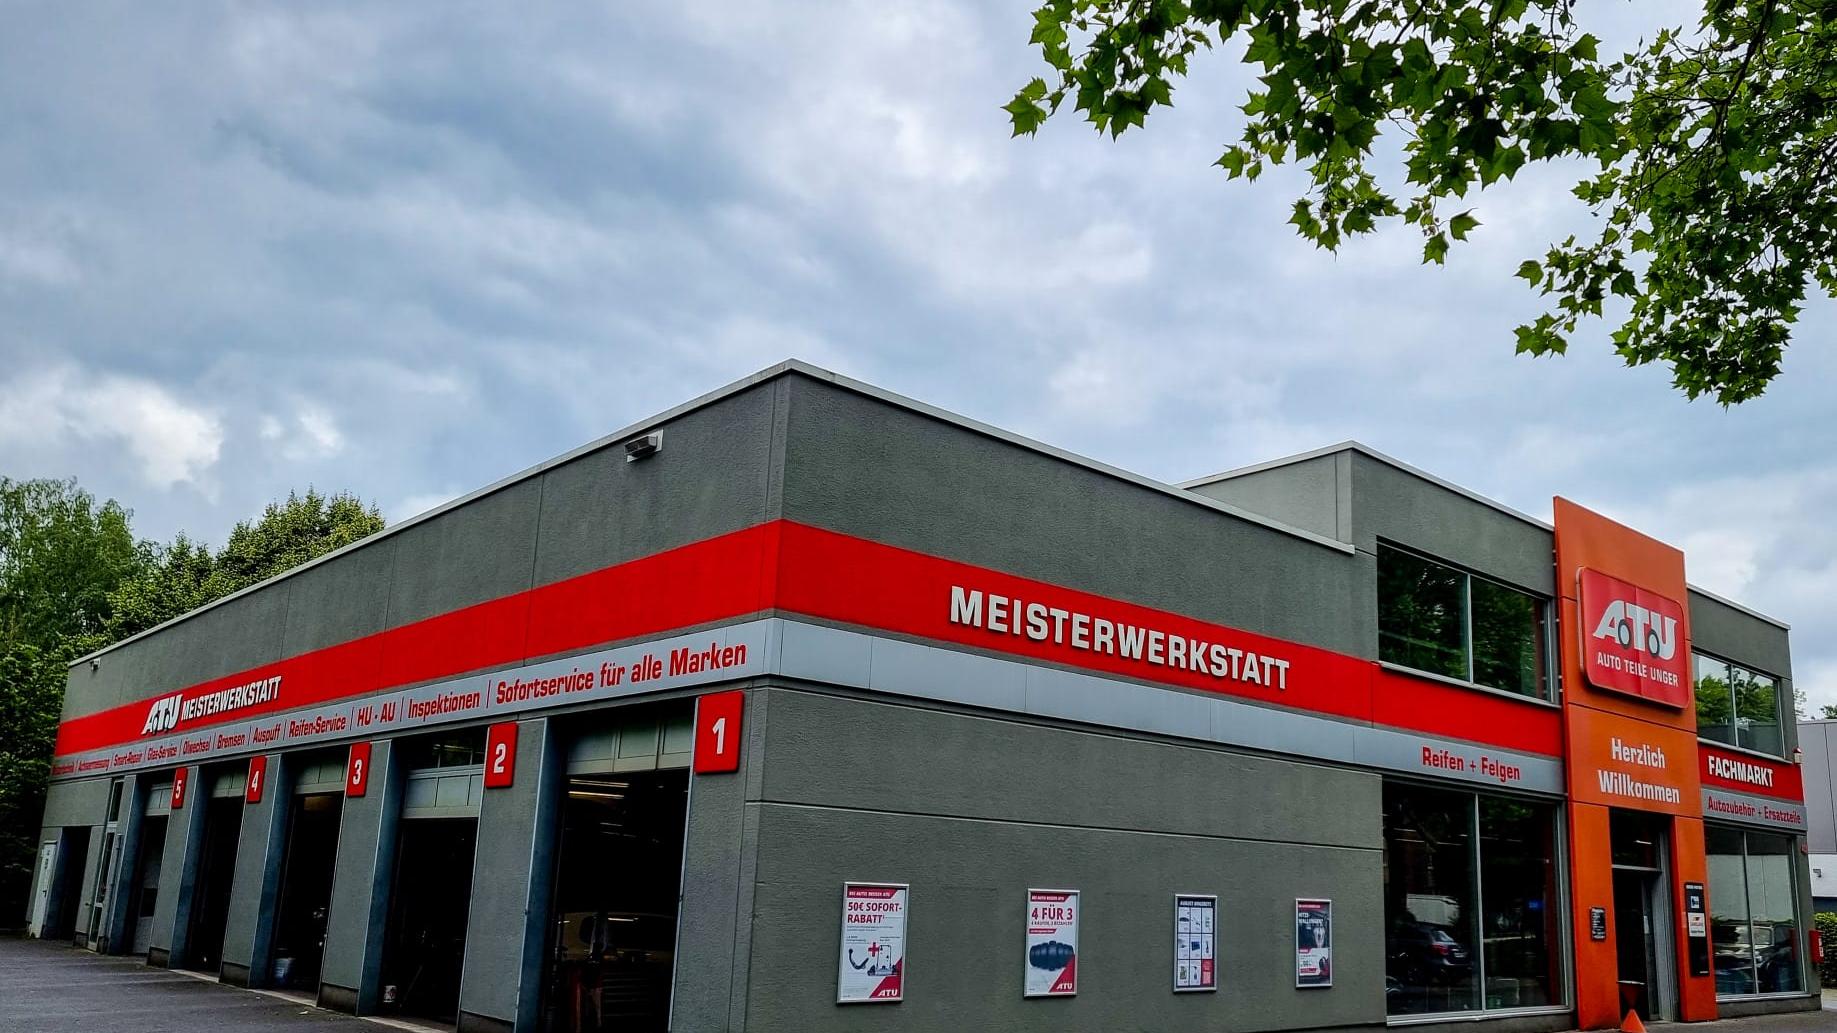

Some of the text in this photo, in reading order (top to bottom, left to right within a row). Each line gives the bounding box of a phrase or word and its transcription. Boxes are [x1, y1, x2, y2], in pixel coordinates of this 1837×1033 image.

[950, 585, 1290, 689] MEISTERWERKSTATT
[1592, 600, 1677, 661] ATU
[1597, 652, 1679, 688] AUTO TEILE UNGER
[141, 675, 282, 735] ATU MEISTERWERKSTATT
[217, 734, 246, 749] Bremsen
[252, 723, 281, 747] Auspuff
[289, 713, 346, 738] Reifen-Service
[357, 707, 373, 727] HU
[379, 701, 396, 723] AU
[408, 692, 480, 722] Inspektionen
[496, 668, 594, 705] Sofortservice
[600, 662, 625, 688] für
[631, 654, 662, 684] alle
[669, 643, 747, 677] Marken
[712, 717, 726, 755] 1
[493, 743, 506, 773] 2
[1422, 746, 1464, 772] Reifen
[1481, 757, 1520, 783] Felgen
[1611, 737, 1666, 769] Herzlich
[251, 770, 260, 792] 4
[352, 759, 363, 785] 3
[1597, 770, 1681, 804] Willkommen
[1708, 755, 1773, 788] FACHMARKT
[175, 780, 182, 799] 5
[1708, 796, 1756, 817] Autozubehör
[1764, 806, 1801, 825] Ersatzteile
[847, 902, 902, 912] 50€ SOFORT-
[1031, 903, 1073, 920] 4 FÜR 3
[879, 988, 898, 997] ATU
